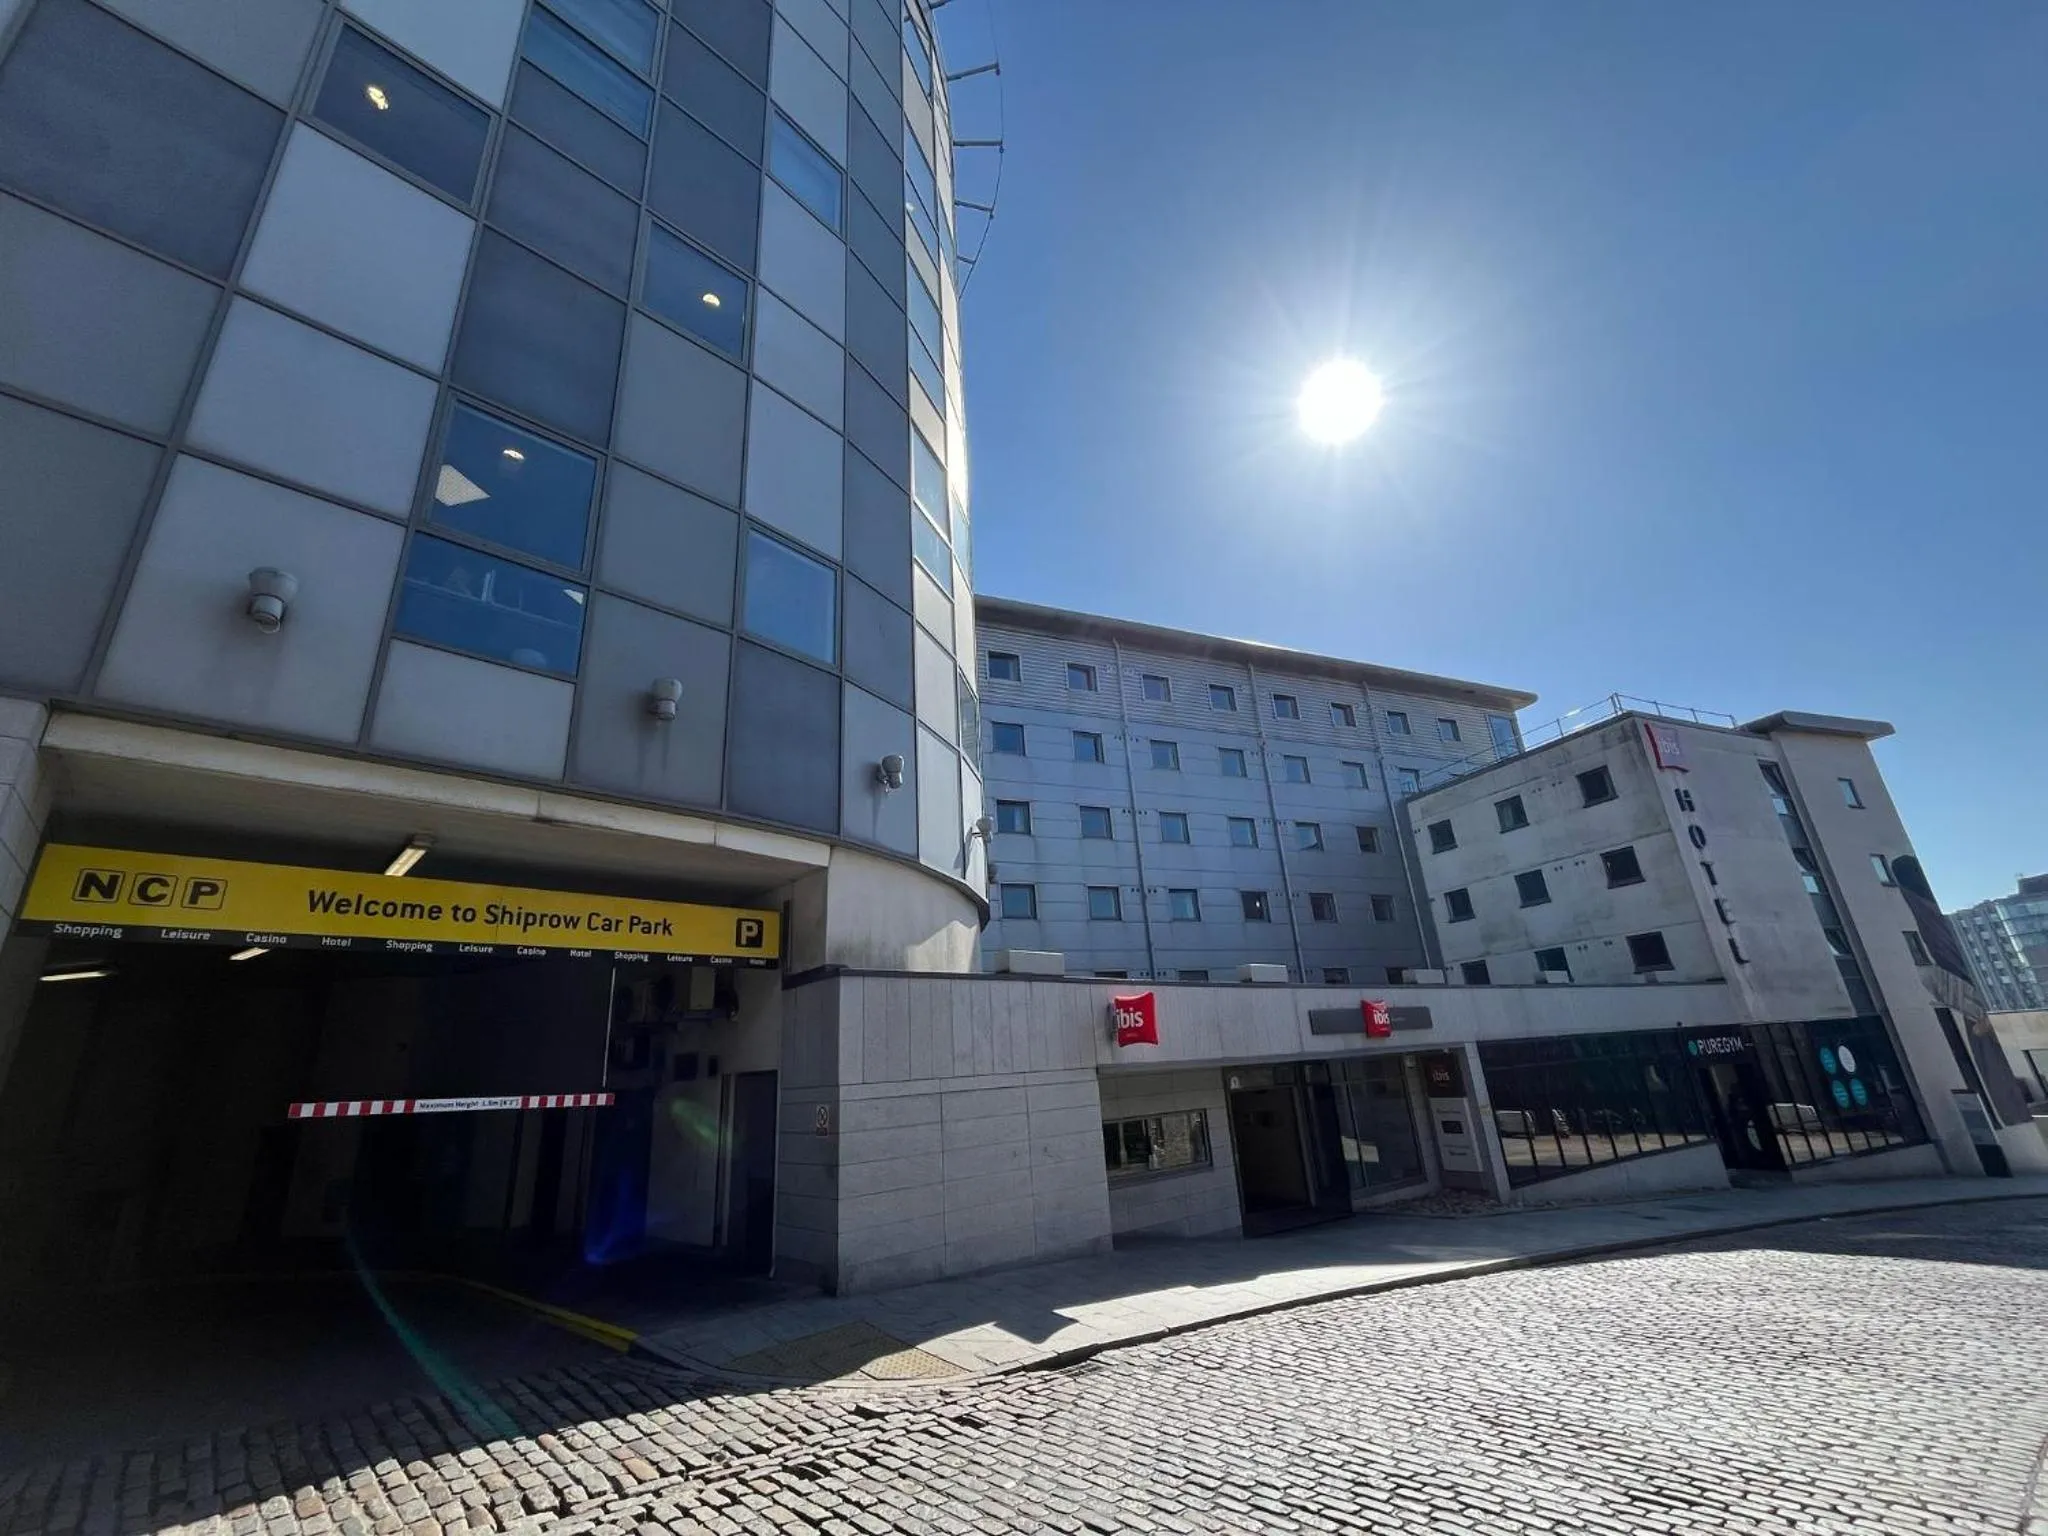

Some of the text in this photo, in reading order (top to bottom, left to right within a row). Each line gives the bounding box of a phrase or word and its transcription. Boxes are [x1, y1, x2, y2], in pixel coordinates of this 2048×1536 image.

[78, 871, 220, 905] NCP
[1674, 788, 1750, 965] HOTEL
[308, 889, 673, 936] Welcome to Shiprow Car Park
[54, 924, 123, 939] Shopping
[161, 929, 211, 941] Leisure
[245, 933, 287, 944] Casino
[321, 936, 351, 947] Hotel
[385, 939, 433, 953] Shopping
[459, 943, 494, 954] Leisure
[516, 946, 547, 956] Casino
[569, 949, 592, 958] Hotel
[614, 951, 649, 963] Shopping
[739, 920, 760, 945] P
[1115, 1007, 1144, 1029] ibis
[1373, 1009, 1390, 1025] ibis
[1696, 1036, 1744, 1055] PUREGYM
